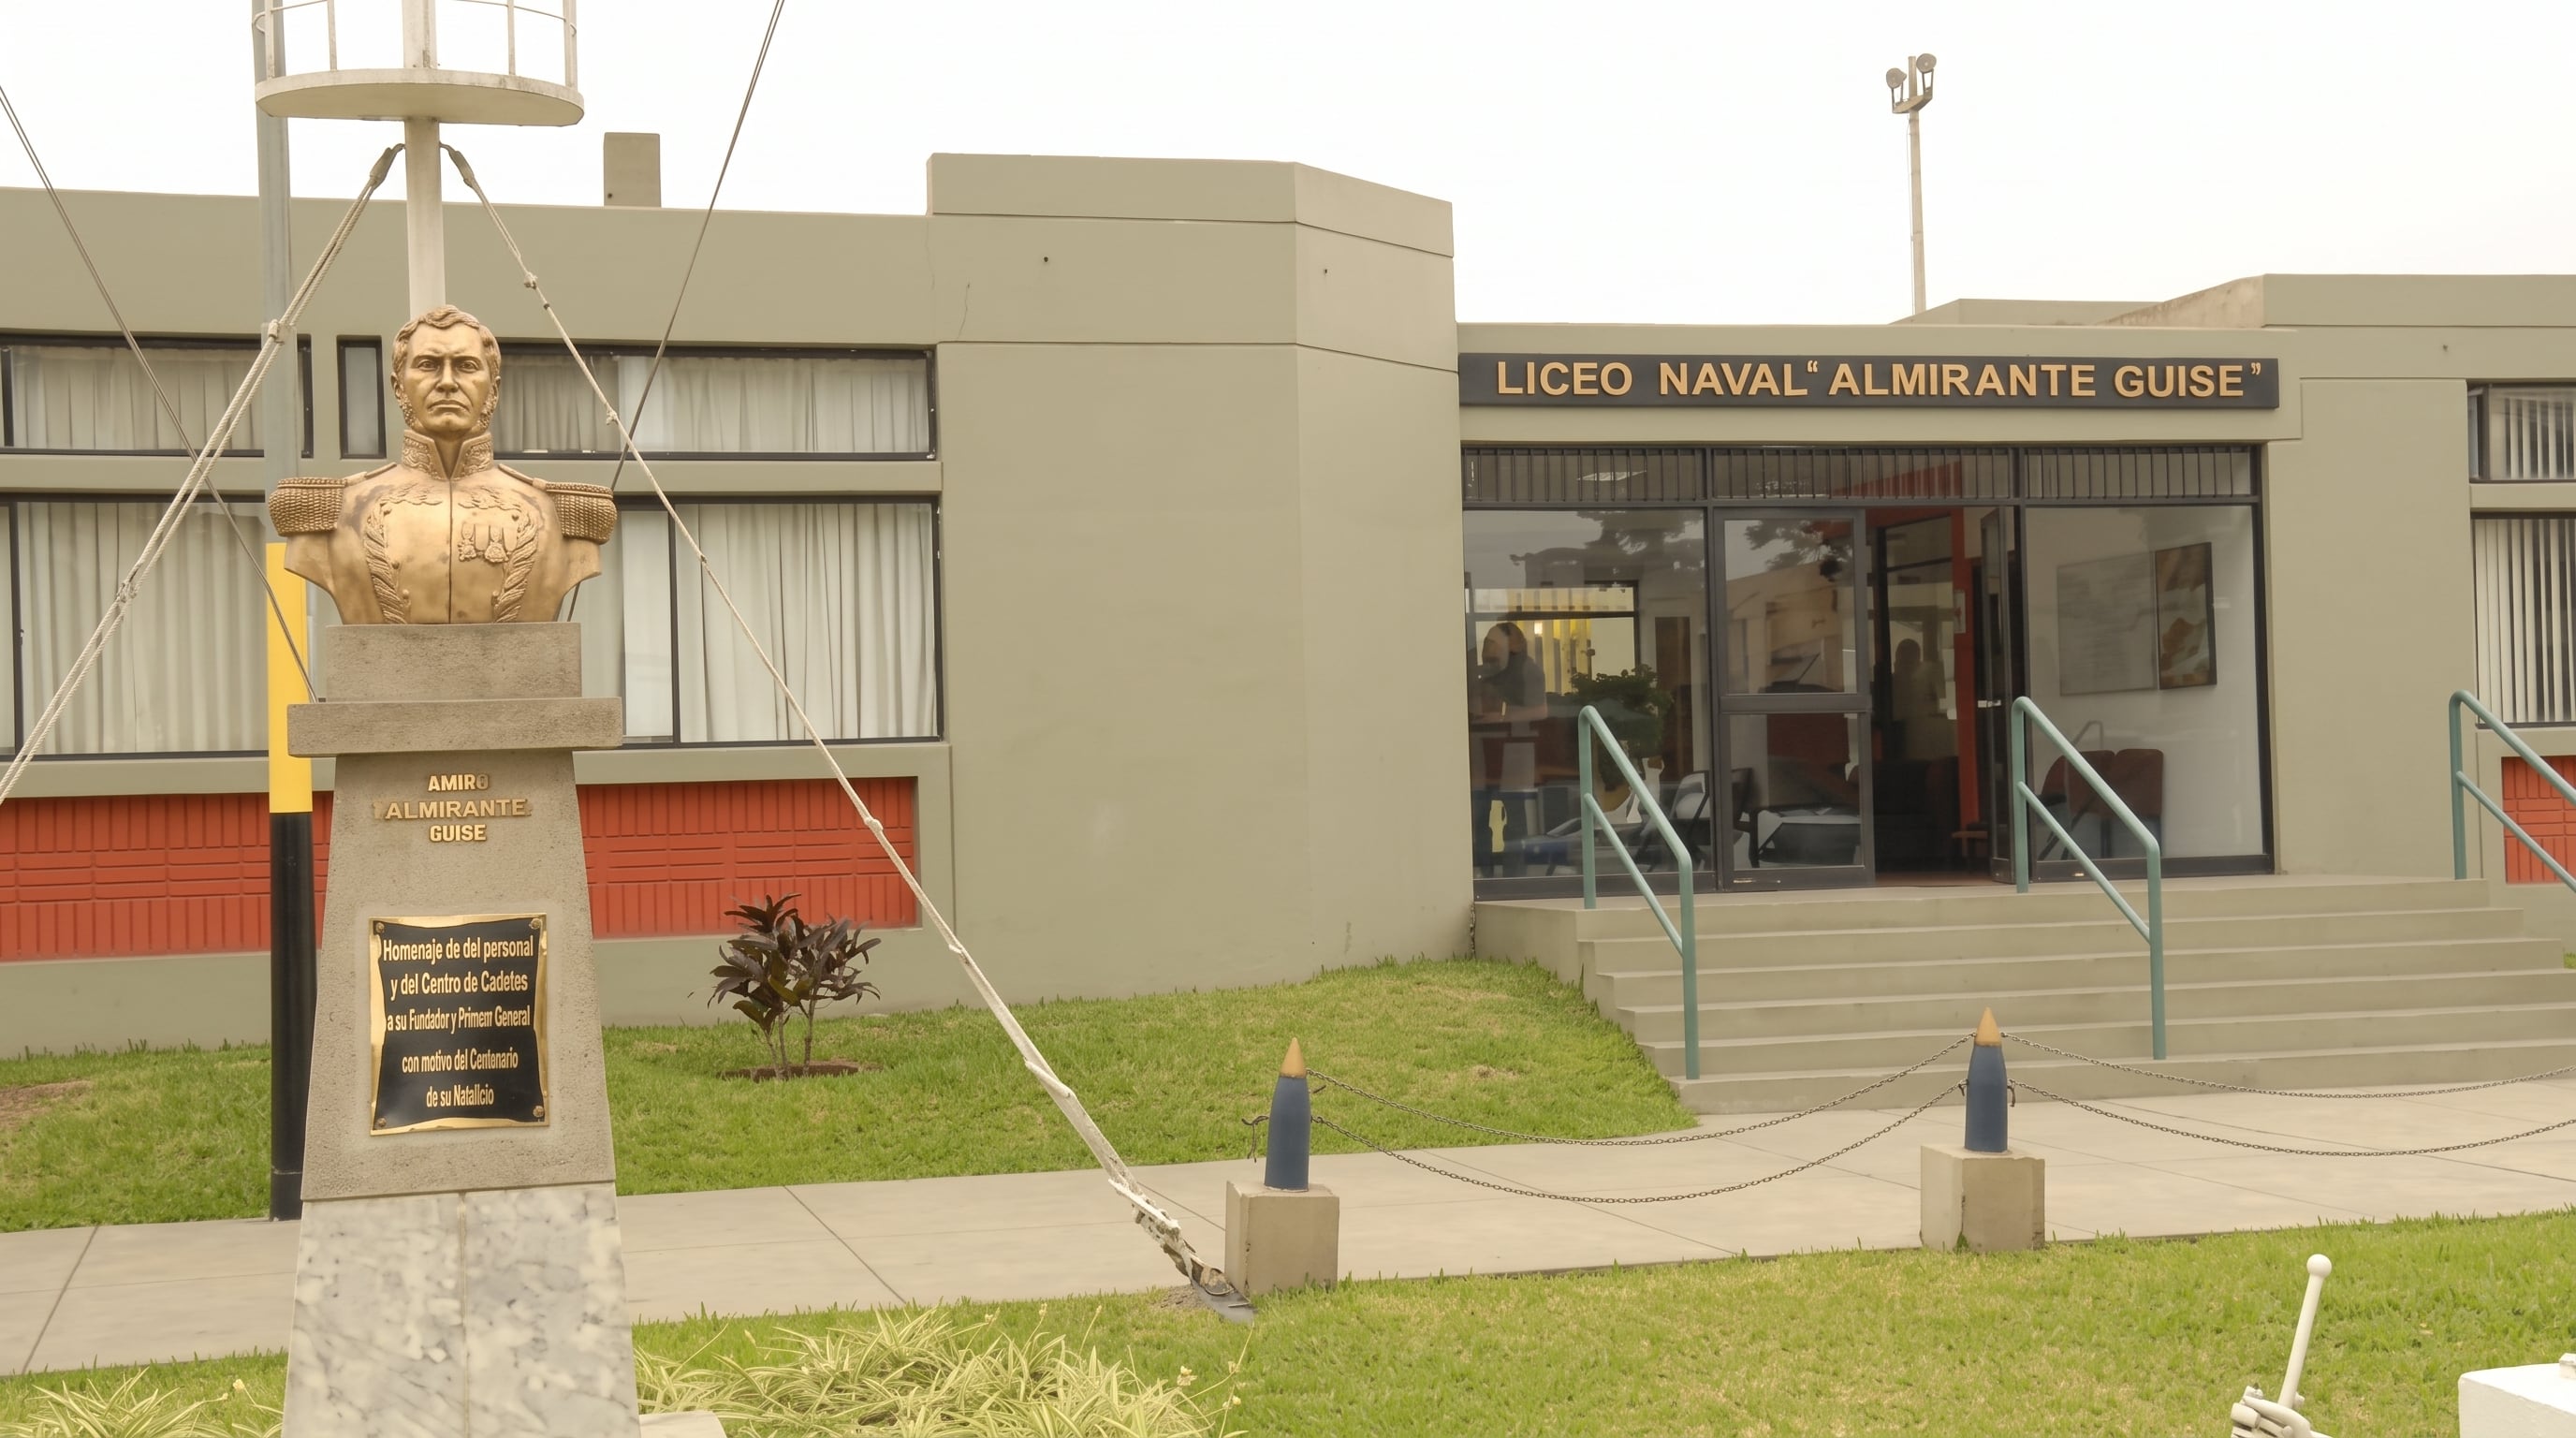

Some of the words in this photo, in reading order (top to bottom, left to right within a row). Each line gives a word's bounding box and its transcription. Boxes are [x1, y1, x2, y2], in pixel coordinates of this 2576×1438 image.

[1498, 361, 1632, 396] LICEO
[1660, 362, 1808, 396] NAVAL
[430, 825, 487, 842] GUISE
[383, 938, 443, 965] Homenaje
[446, 938, 461, 960] de
[462, 937, 481, 959] del
[483, 935, 534, 963] personal
[390, 978, 399, 1001] y
[400, 973, 418, 995] del
[421, 972, 461, 993] Centro
[463, 971, 478, 992] de
[481, 969, 529, 992] Cadetes
[388, 1015, 394, 1031] a
[395, 1014, 407, 1031] su
[409, 1007, 449, 1031] Fundador
[450, 1012, 458, 1034] y
[494, 1005, 531, 1027] General
[402, 1056, 419, 1073] con
[421, 1049, 452, 1072] motivo
[454, 1048, 469, 1070] del
[426, 1086, 438, 1108] de
[440, 1091, 452, 1107] su
